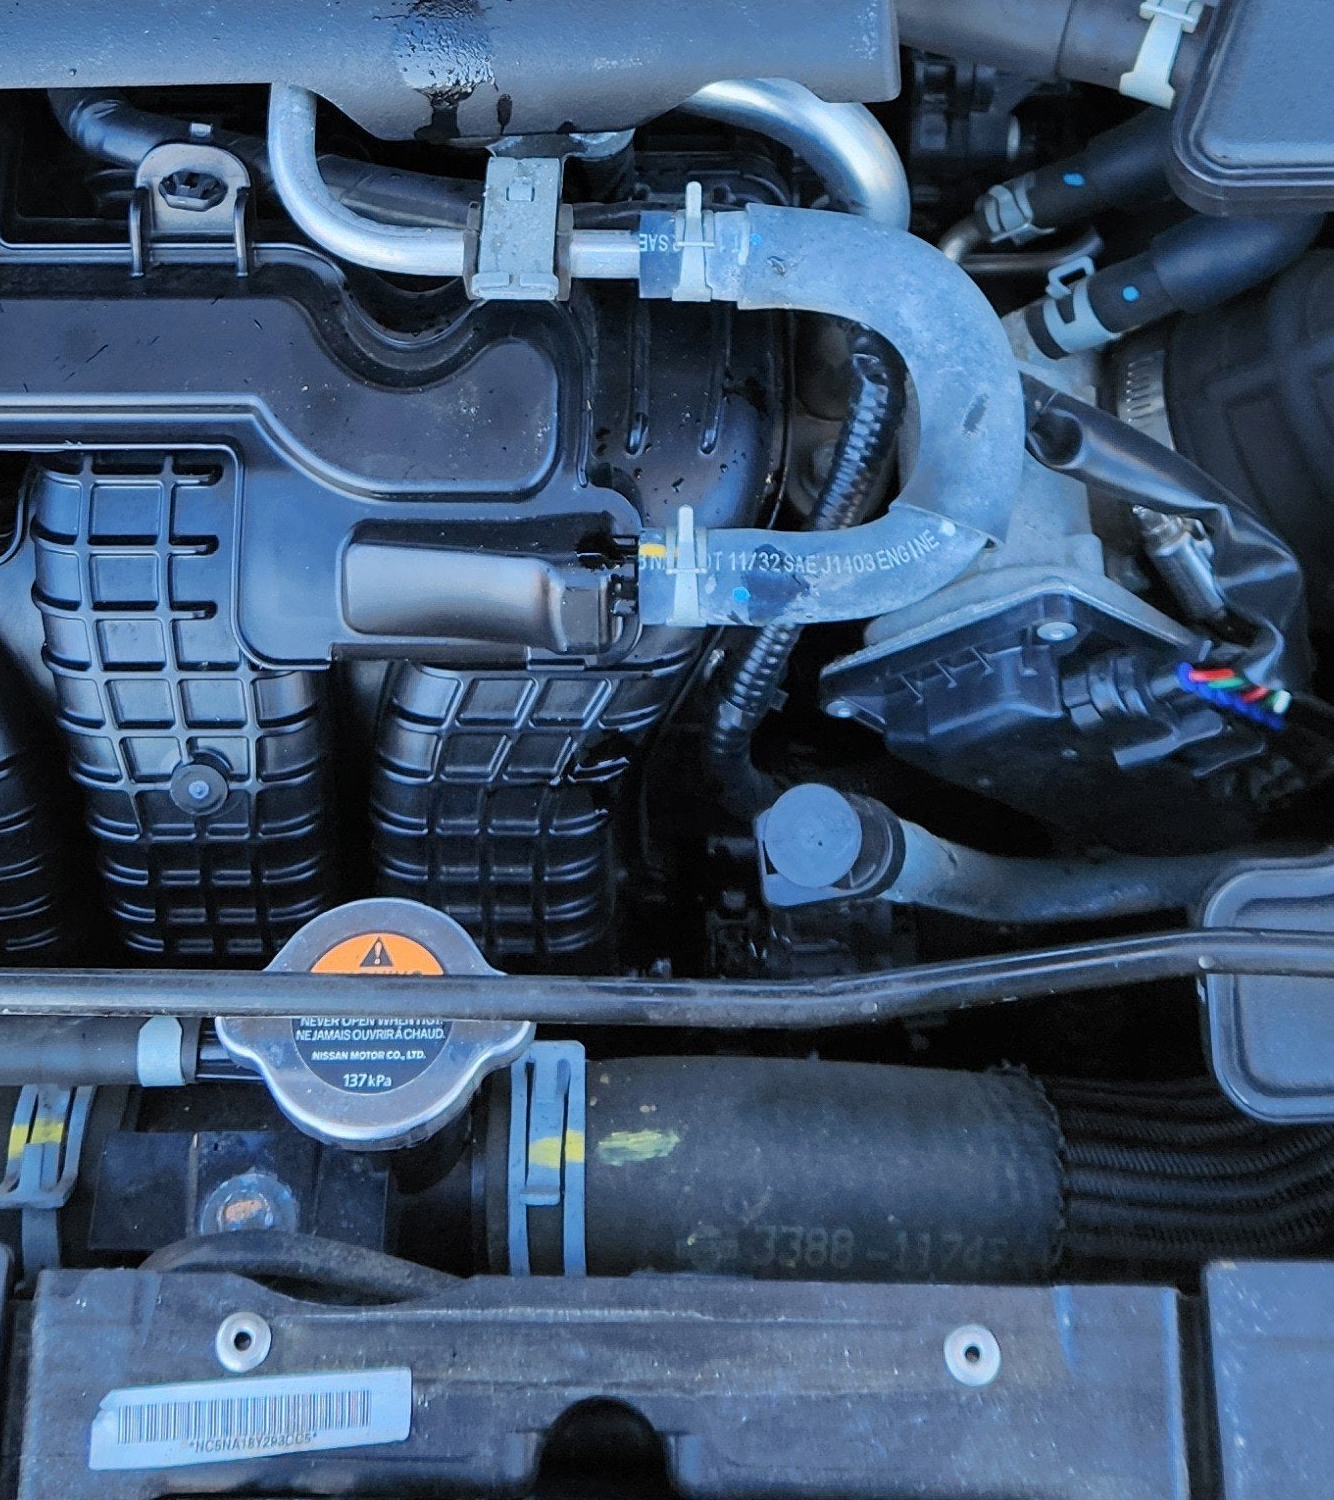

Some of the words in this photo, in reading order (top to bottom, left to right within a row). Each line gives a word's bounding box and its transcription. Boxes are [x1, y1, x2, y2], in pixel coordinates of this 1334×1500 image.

[639, 233, 669, 252] SAE
[728, 551, 781, 571] 11/32
[784, 553, 817, 574] SAE
[820, 552, 876, 574] J1403
[876, 529, 940, 571] ENGINE
[296, 1029, 312, 1041] NE
[312, 1029, 351, 1041] JAMAIS
[352, 1028, 395, 1040] OUVRIR
[404, 1028, 446, 1040] CHAUD.
[311, 1050, 348, 1060] NISSAN
[350, 1050, 385, 1060] MOTOR
[406, 1050, 427, 1060] LTD.
